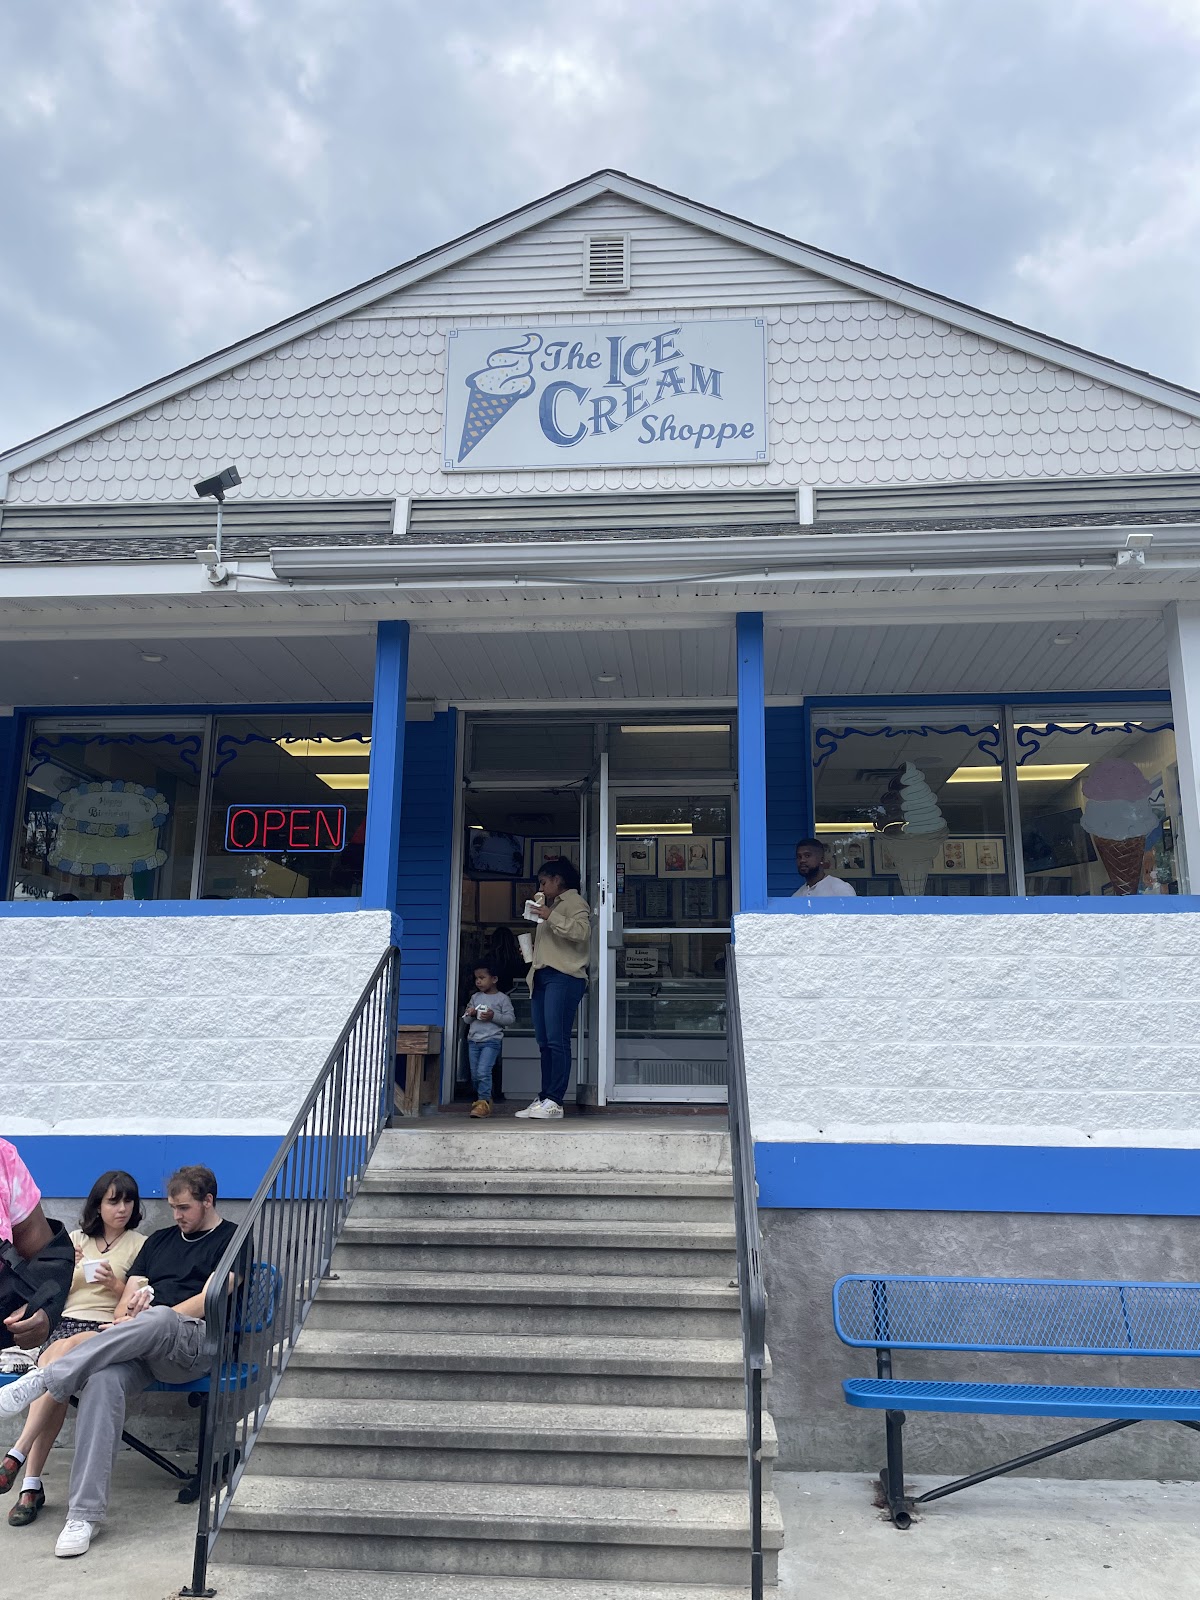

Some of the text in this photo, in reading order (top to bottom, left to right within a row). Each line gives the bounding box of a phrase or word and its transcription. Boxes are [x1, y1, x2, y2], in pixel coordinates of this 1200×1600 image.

[540, 327, 685, 388] The ICE
[538, 362, 724, 448] CREAM
[637, 414, 755, 449] Shoppe
[99, 796, 123, 807] Happy
[230, 808, 342, 848] OPEN
